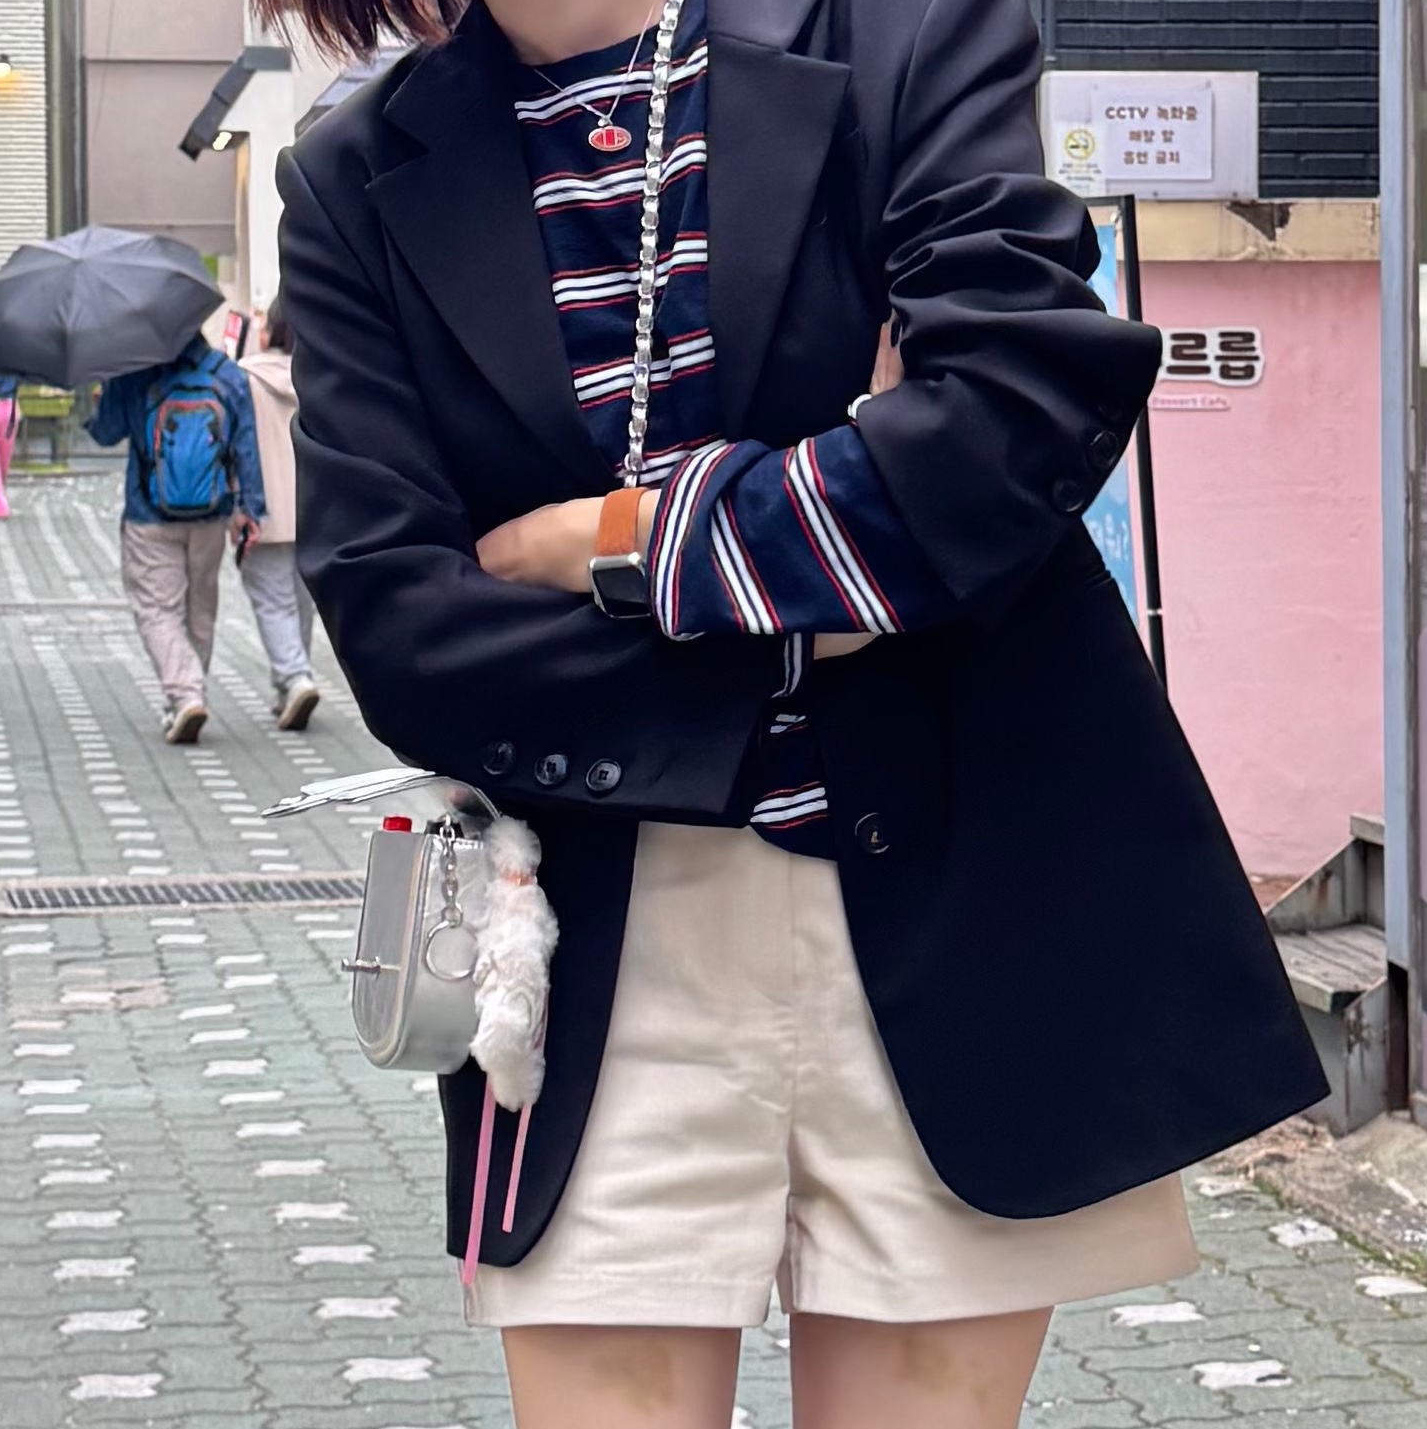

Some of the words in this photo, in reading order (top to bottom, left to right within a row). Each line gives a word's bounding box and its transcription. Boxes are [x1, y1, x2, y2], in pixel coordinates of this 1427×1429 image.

[1104, 106, 1149, 120] CCTV
[1157, 105, 1198, 121] 녹화중
[1123, 151, 1149, 166] 흡연
[1155, 151, 1181, 165] 금지
[1165, 332, 1261, 381] 르릅
